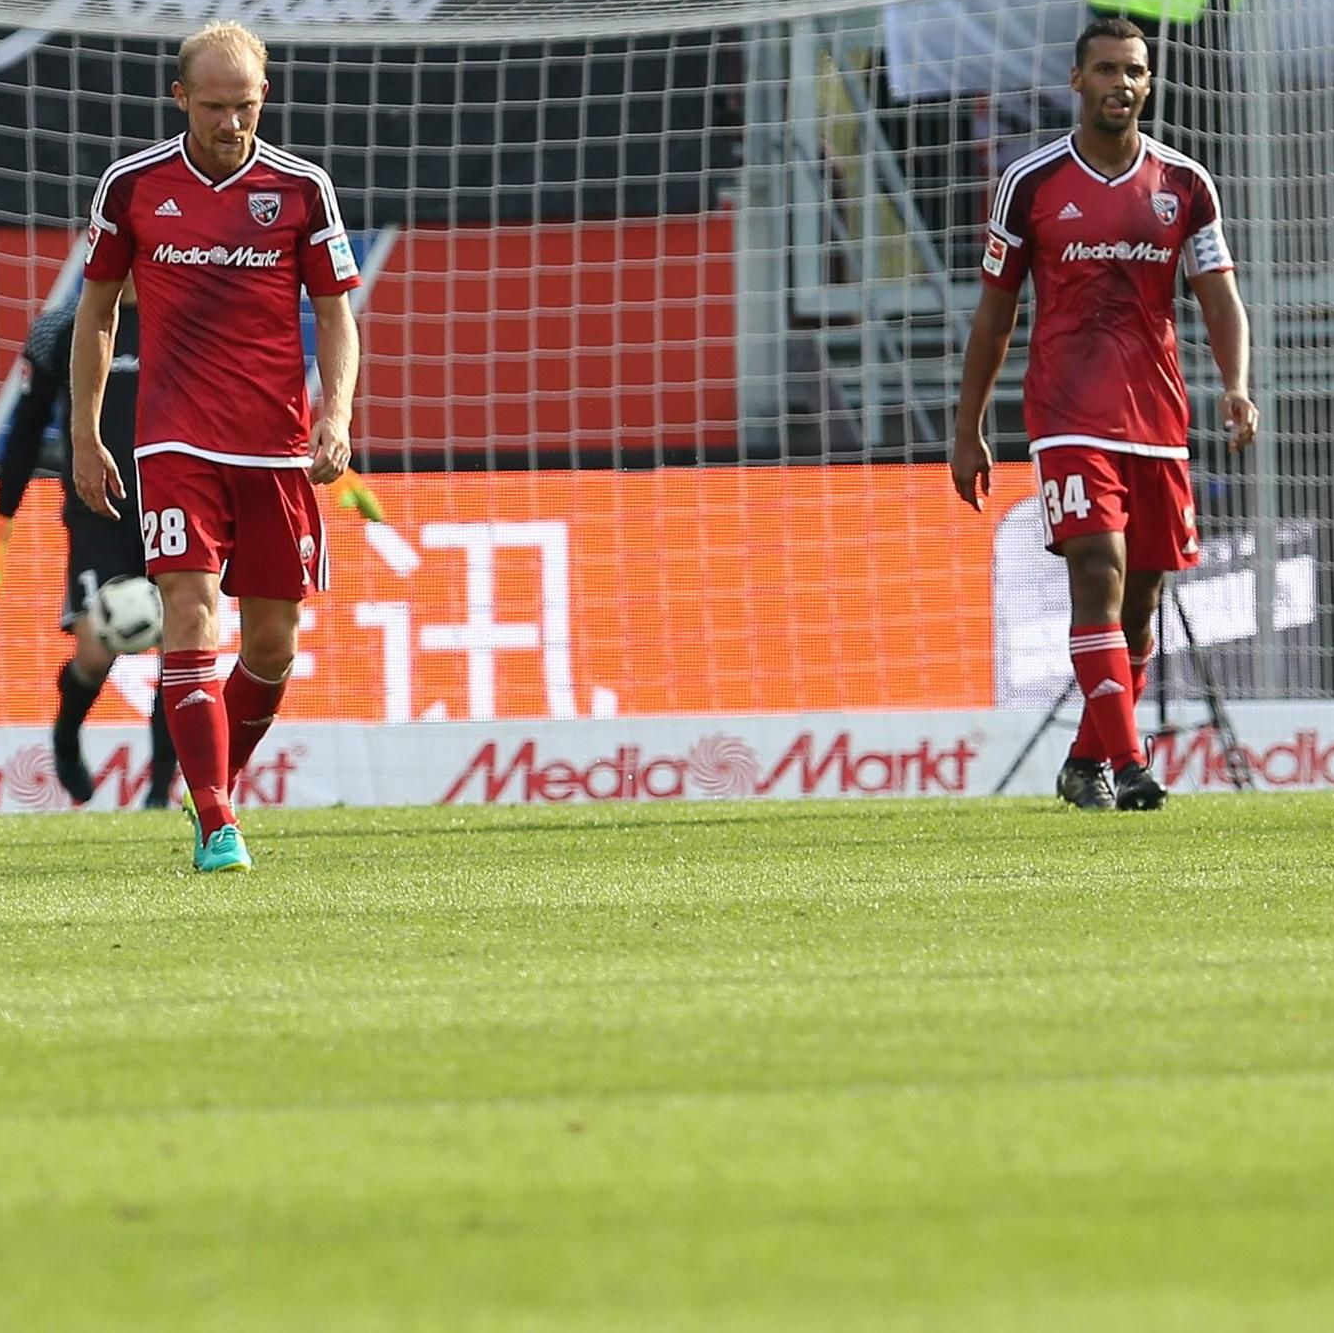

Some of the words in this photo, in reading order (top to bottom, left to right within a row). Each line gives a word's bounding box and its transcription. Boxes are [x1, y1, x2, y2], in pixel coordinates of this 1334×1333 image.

[152, 244, 210, 265] Media
[224, 246, 281, 266] Markt
[1061, 241, 1115, 262] Media
[1128, 242, 1172, 262] Markt
[1043, 474, 1091, 525] 34
[143, 507, 188, 562] 28
[438, 740, 686, 806] Media
[756, 731, 979, 796] Markt
